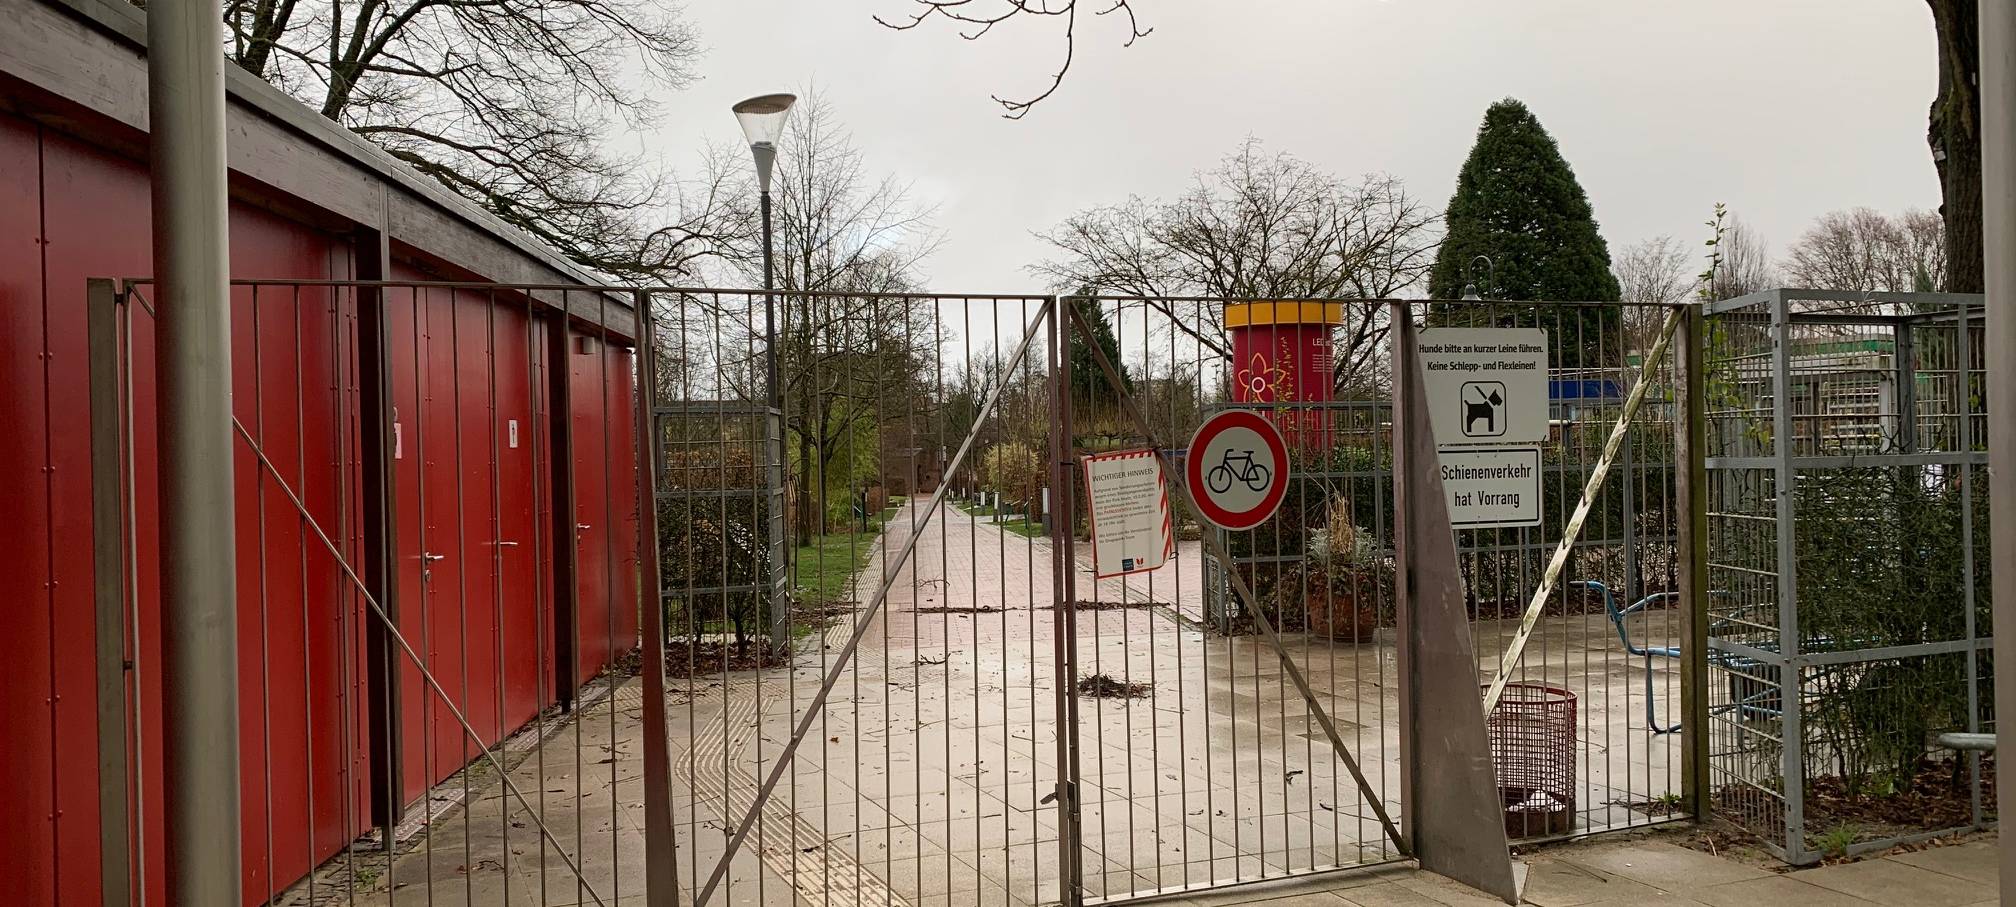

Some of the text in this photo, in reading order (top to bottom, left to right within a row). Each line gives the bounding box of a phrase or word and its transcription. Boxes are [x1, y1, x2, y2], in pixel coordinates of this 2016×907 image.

[1418, 344, 1443, 353] Hunde
[1444, 344, 1462, 353] bitte
[1473, 344, 1497, 353] kurzer
[1498, 344, 1518, 353] Leine
[1518, 344, 1544, 353] führen.
[1427, 361, 1536, 372] Keine Schlepp- und Flexleinen!
[1092, 468, 1154, 482] WICHTIGER HINWEIS
[1441, 463, 1532, 480] Schienenverkehr
[1454, 490, 1520, 508] hat Vorrang
